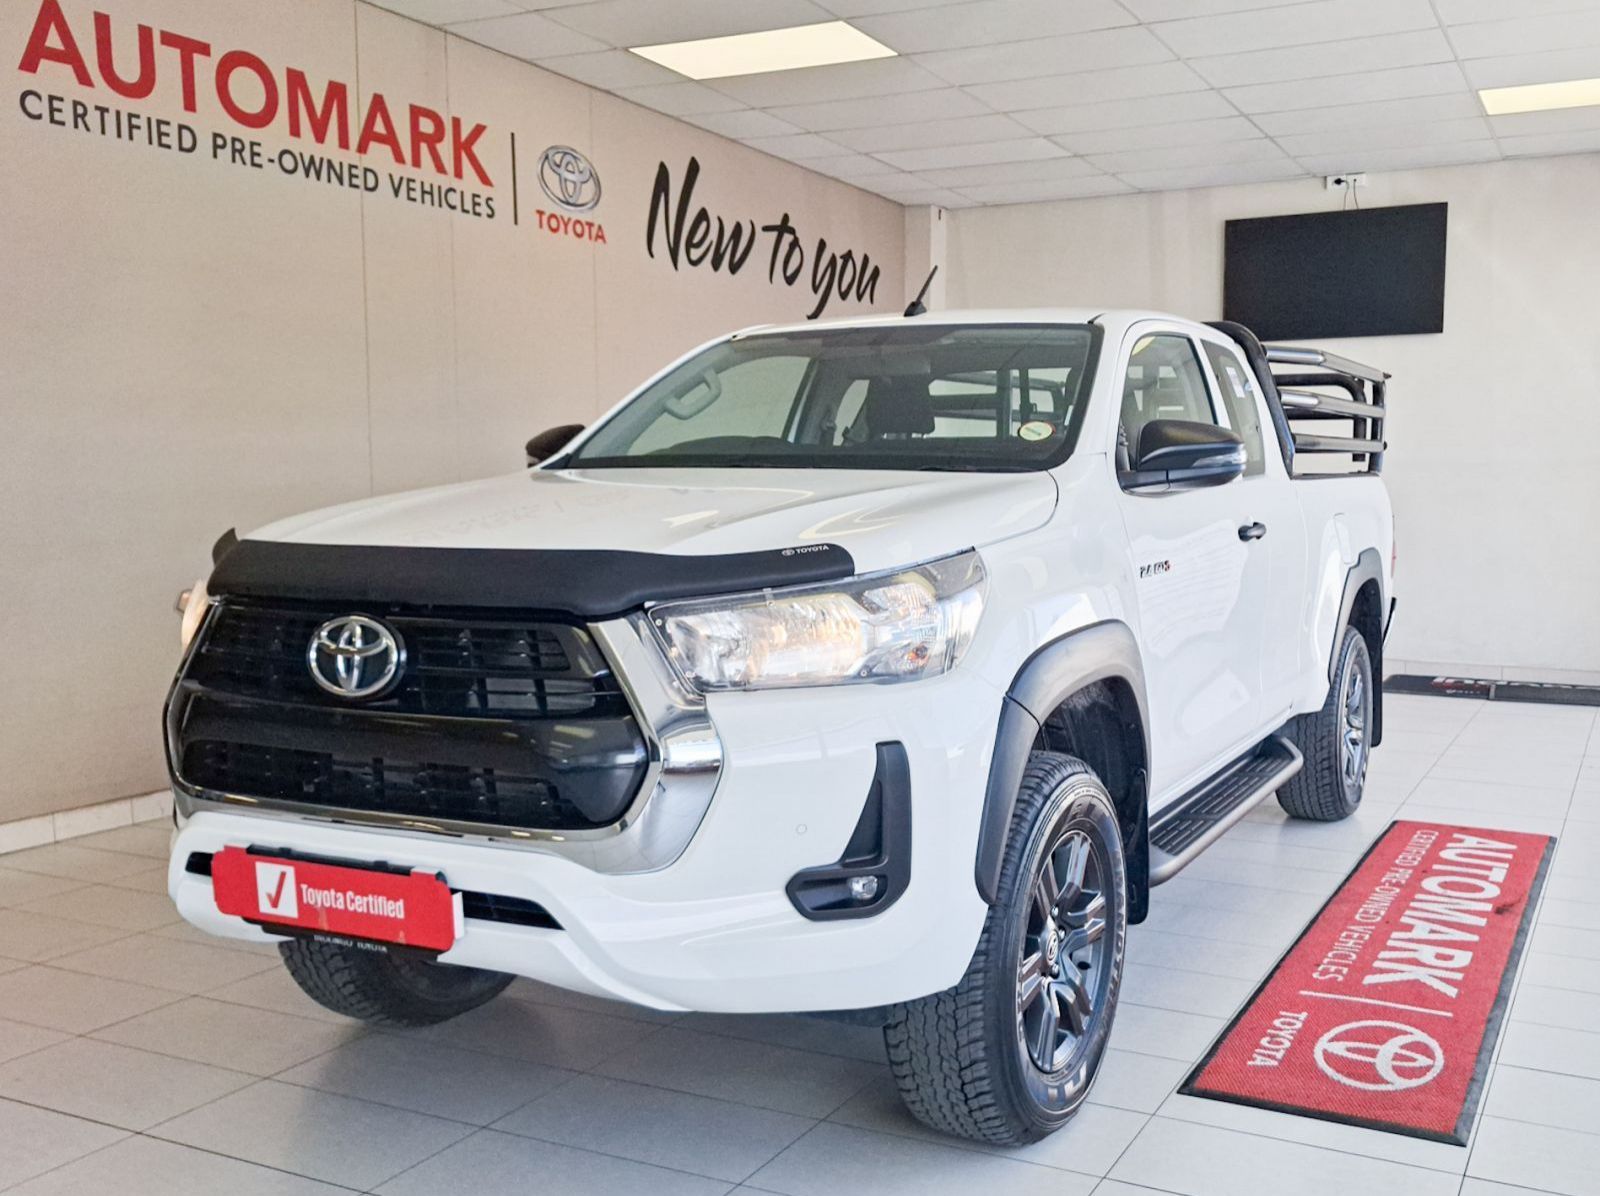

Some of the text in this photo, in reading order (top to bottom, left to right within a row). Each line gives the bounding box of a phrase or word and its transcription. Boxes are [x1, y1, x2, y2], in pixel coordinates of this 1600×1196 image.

[18, 0, 494, 188] AUTOMARK
[19, 89, 496, 219] CERTIFIED PRE-OWNED VEHICLES
[535, 208, 607, 244] TOYOTA
[647, 156, 880, 320] New to you
[795, 545, 829, 554] TOYOTA
[300, 883, 405, 919] Toyota Certified
[1312, 829, 1439, 983] CERTIFIED PRE-OWNED VEHICLES
[1362, 833, 1517, 998] AUTOMARK
[1246, 1010, 1308, 1067] TOYOTA
